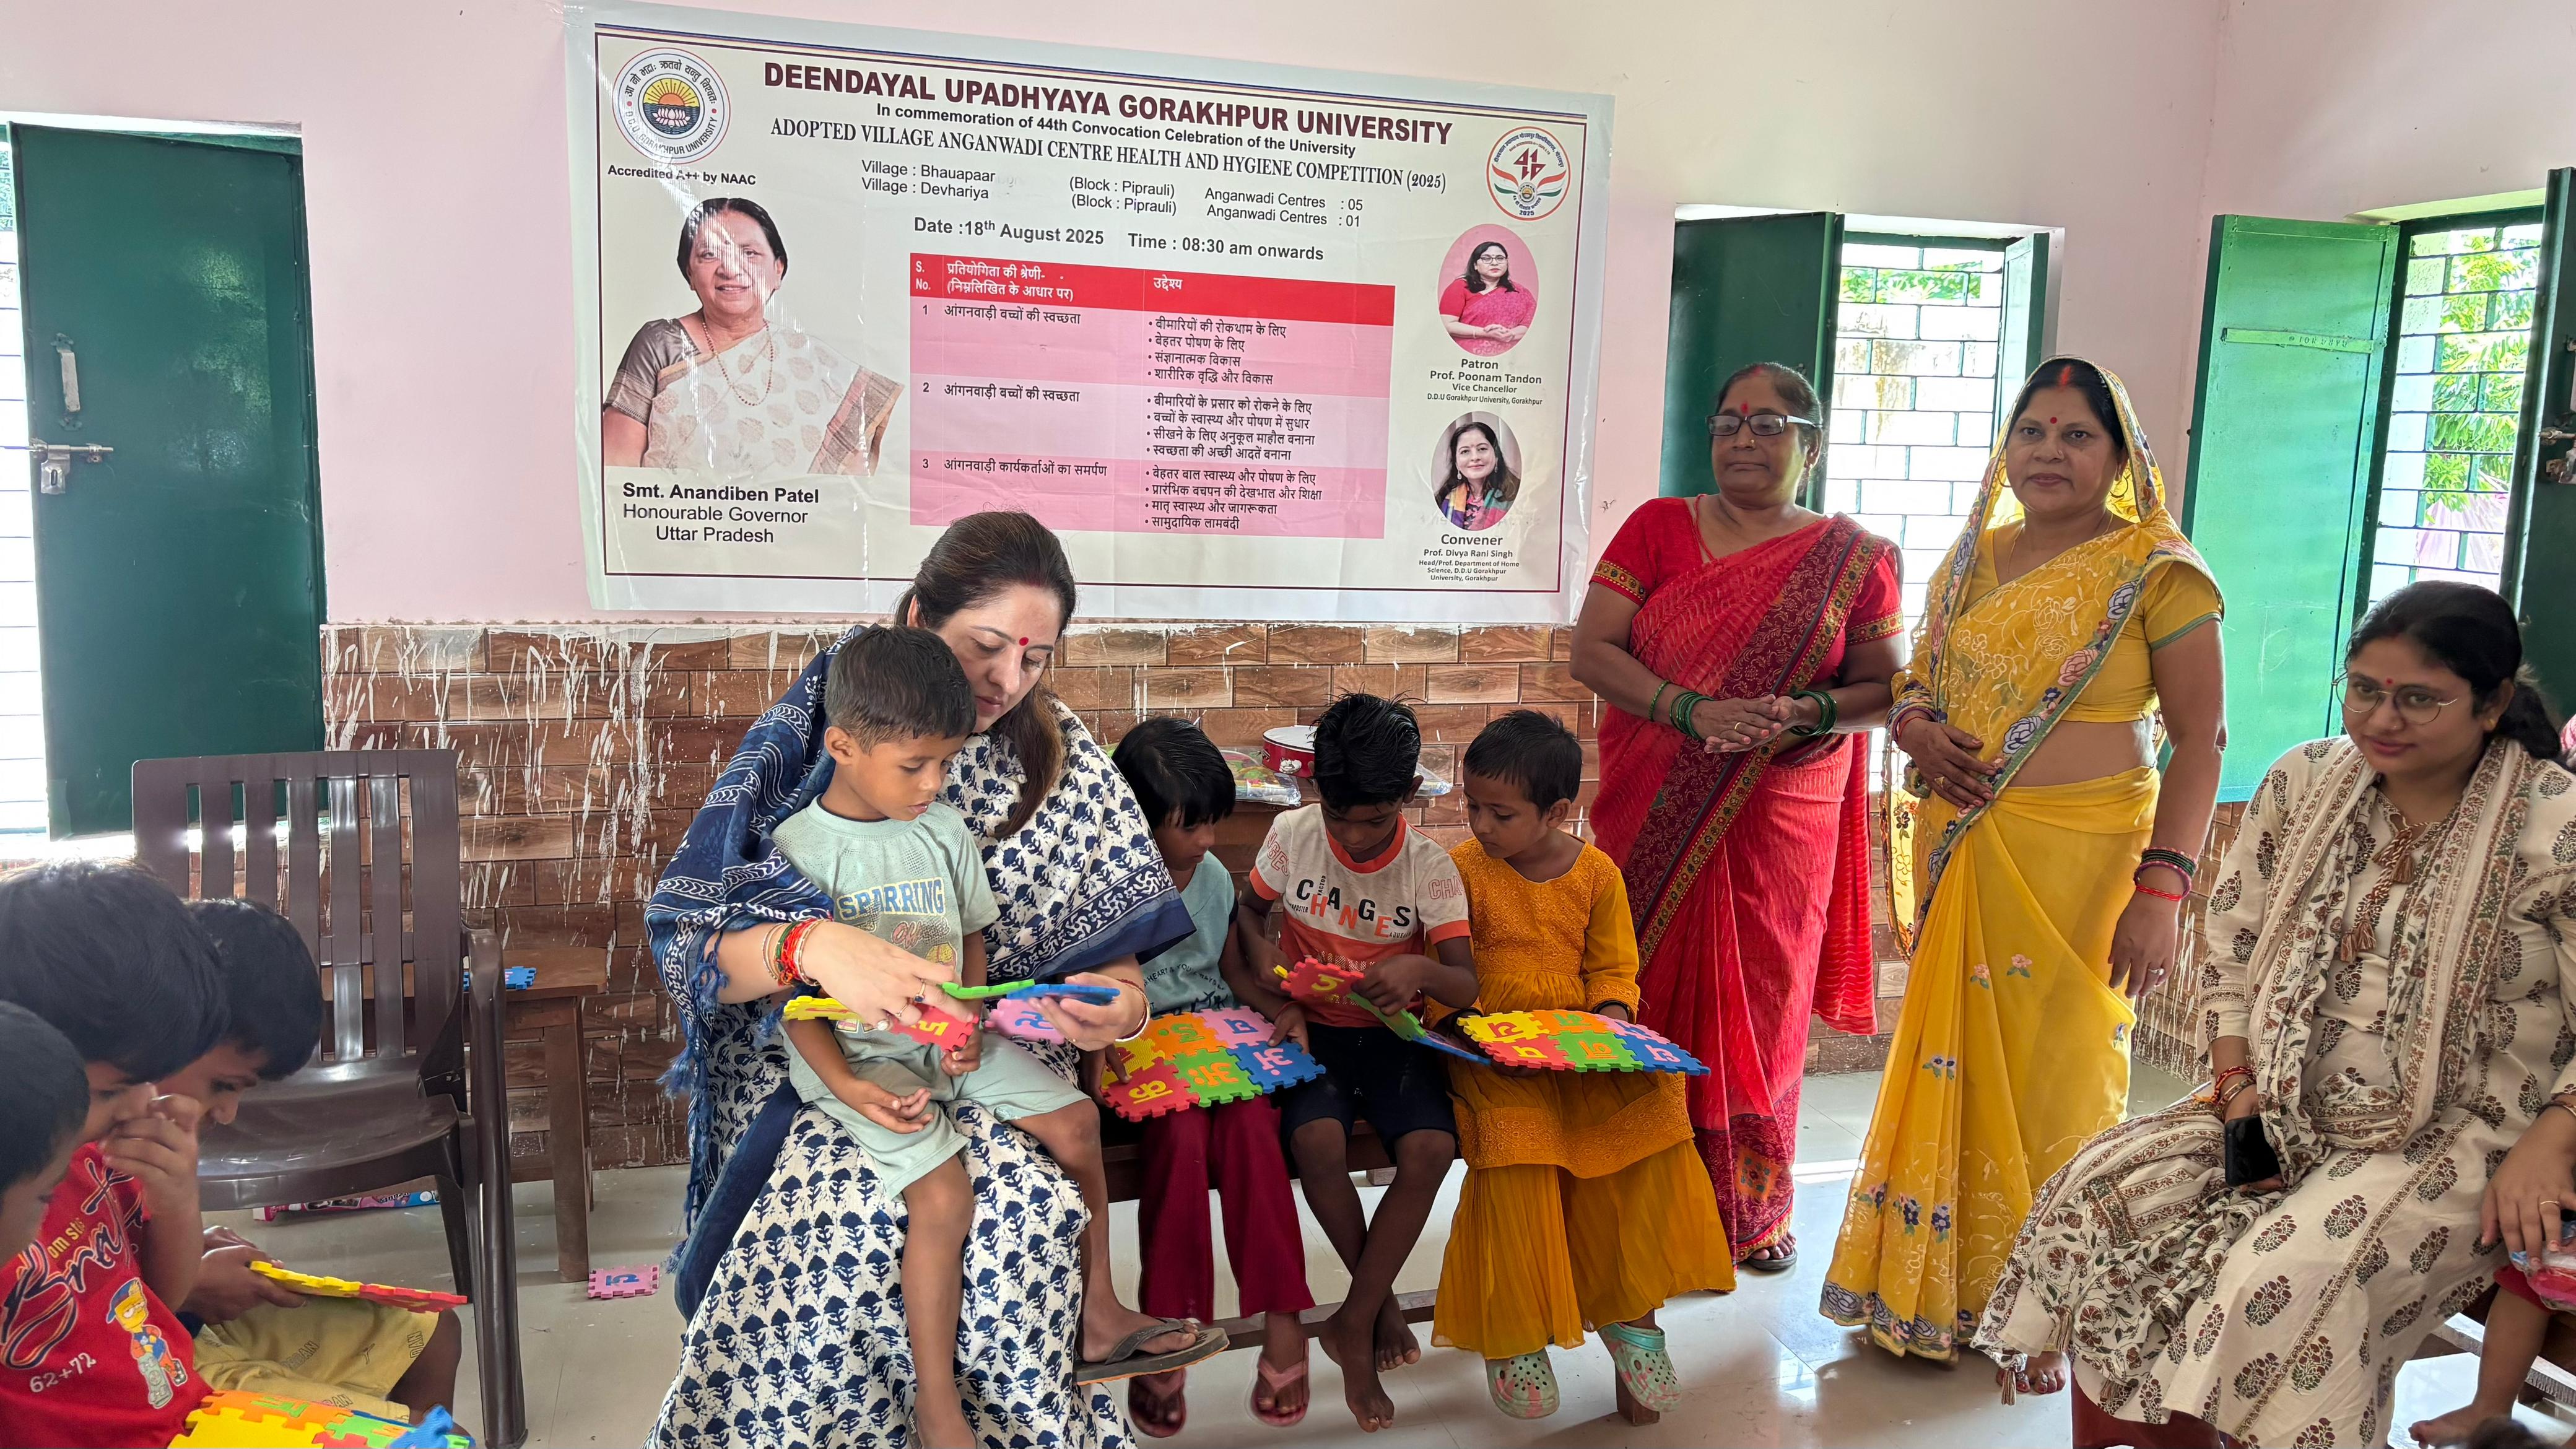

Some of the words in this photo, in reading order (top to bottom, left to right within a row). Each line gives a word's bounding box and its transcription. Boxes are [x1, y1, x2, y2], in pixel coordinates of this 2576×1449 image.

[765, 62, 936, 101] DEENDAYAL
[945, 78, 1111, 116] UPADHYAYA
[1119, 94, 1289, 131] GORAKHPUR
[1297, 110, 1453, 145] UNIVERSITY
[686, 116, 718, 152] UNIVERSITY
[877, 103, 890, 116] In
[895, 108, 1014, 127] commemoration
[1019, 116, 1033, 129] of
[1037, 117, 1068, 132] 44th
[1072, 120, 1160, 139] Convocation
[1165, 128, 1243, 147] Celebration
[1247, 136, 1261, 148] of
[1264, 137, 1286, 150] the
[1289, 138, 1356, 159] University
[770, 118, 856, 141] ADOPTED
[861, 124, 934, 147] VILLAGE
[938, 131, 1043, 157] ANGANWADI
[1047, 141, 1113, 162] CENTRE
[1116, 146, 1181, 168] HEALTH
[1185, 152, 1219, 170] AND
[1222, 155, 1292, 177] HYGIENE
[1296, 161, 1404, 185] COMPETITION
[1406, 170, 1446, 194] (2025)
[607, 165, 673, 180] Accredited
[703, 171, 718, 185] by
[721, 173, 756, 185] NAAC
[861, 159, 908, 178] Village
[921, 164, 996, 183] Bhauapaar
[861, 176, 908, 195] Village
[921, 181, 989, 201] Devhariya
[1069, 176, 1110, 192] (Block
[1122, 180, 1175, 199] Piprauli)
[1072, 193, 1112, 209] (Block
[1124, 198, 1177, 217] Piprauli)
[1204, 187, 1274, 204] Anganwadi
[1277, 193, 1326, 208] Centres
[1348, 198, 1363, 211] 05
[1206, 204, 1276, 221] Anganwadi
[1279, 209, 1328, 225] Centres
[1346, 215, 1359, 227] 01
[915, 217, 953, 233] Date
[999, 223, 1061, 243] August
[1065, 228, 1103, 245] 2025
[1128, 233, 1167, 249] Time
[1182, 237, 1224, 253] 08:30
[1229, 243, 1252, 256] am
[1258, 246, 1323, 260] onwards
[916, 261, 925, 272] S.
[916, 278, 931, 290] No.
[923, 304, 928, 315] 1
[1461, 359, 1499, 370] Patron
[1430, 370, 1455, 380] Prof.
[1458, 372, 1502, 382] Poonam
[1504, 373, 1542, 384] Tandon
[923, 382, 929, 393] 2
[1452, 383, 1471, 391] Vice
[1473, 384, 1518, 393] Chancellor
[1446, 394, 1479, 403] Gorakhpur
[1511, 397, 1543, 406] Gorakhpur
[923, 458, 929, 469] 3
[623, 482, 664, 498] Smt.
[669, 484, 768, 502] Anandiben
[775, 487, 819, 503] Patel
[624, 503, 723, 521] Honourable
[729, 507, 809, 523] Governor
[656, 525, 698, 541] Uttar
[703, 526, 773, 543] Pradesh
[1441, 534, 1503, 546] Convener
[1446, 549, 1468, 559] Divya
[1471, 549, 1489, 557] Rani
[1490, 550, 1513, 559] Singh
[1317, 875, 1326, 895] FACTOR
[837, 877, 946, 921] SPARRING
